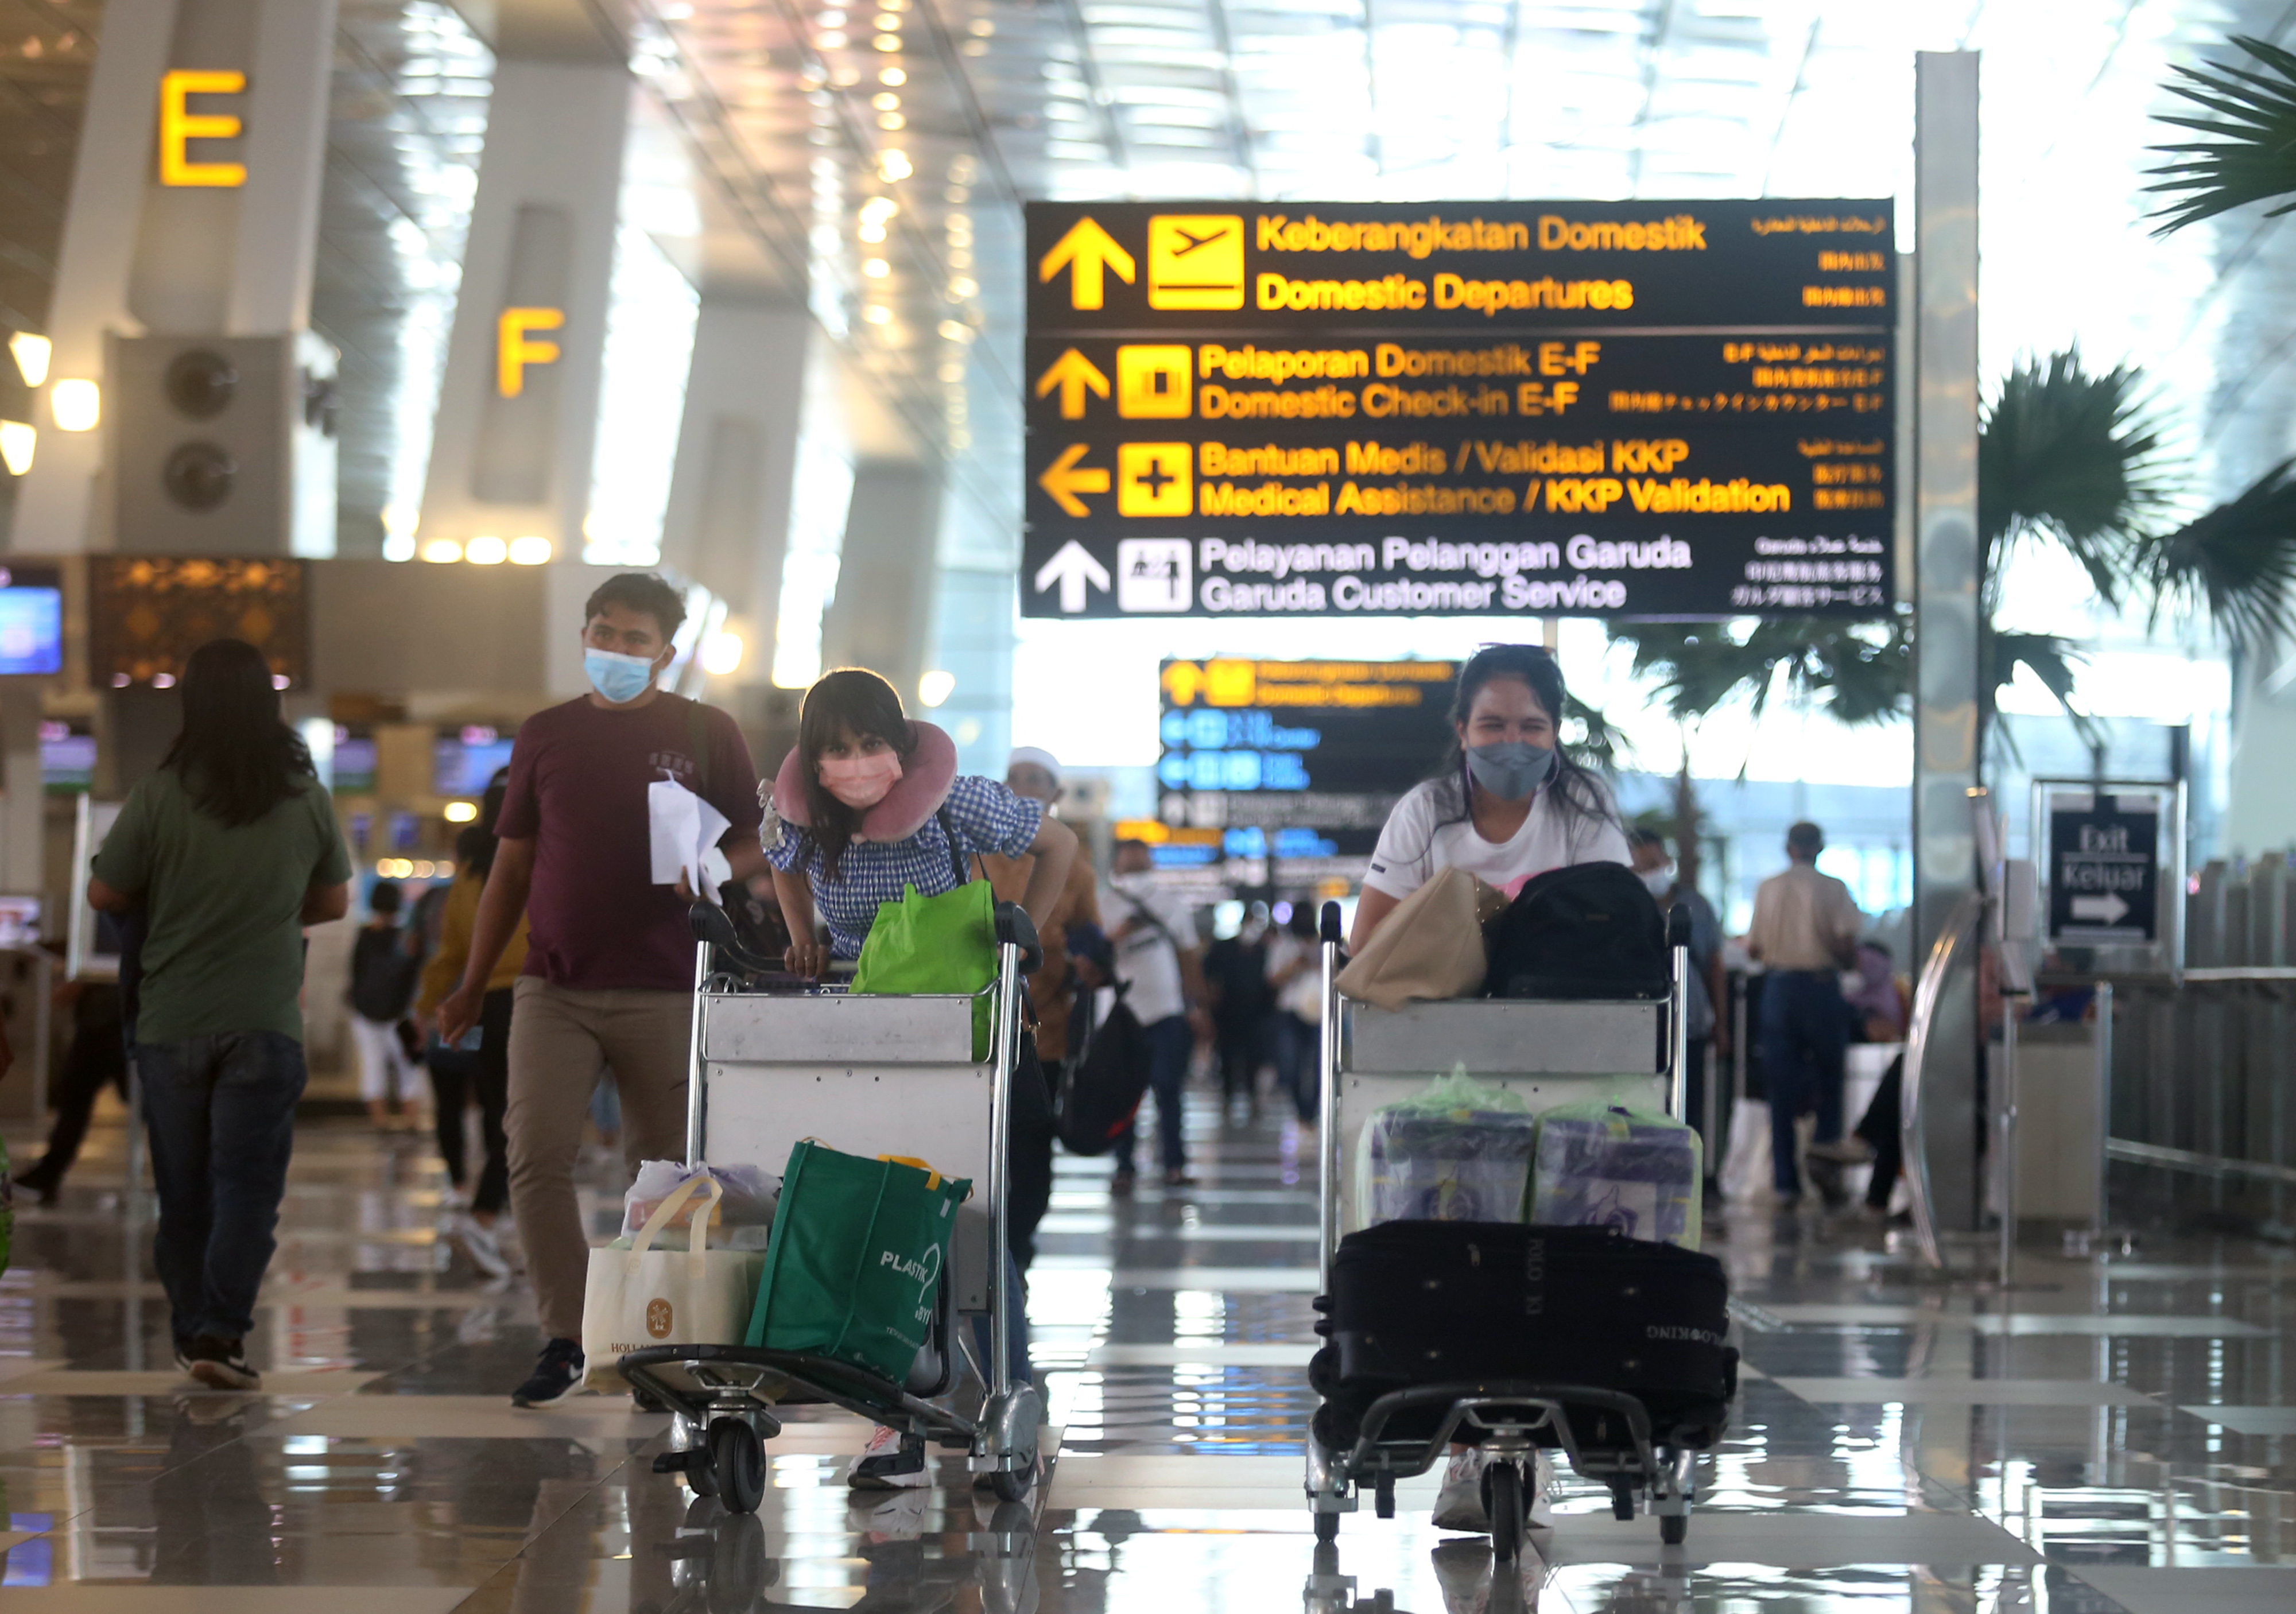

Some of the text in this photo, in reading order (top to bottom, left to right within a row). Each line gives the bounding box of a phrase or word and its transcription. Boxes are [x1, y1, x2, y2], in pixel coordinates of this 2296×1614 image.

[160, 69, 248, 187] E
[1256, 215, 1529, 259] Keberangkatan
[1538, 215, 1707, 251] Domestik
[1256, 273, 1634, 315] Domestic Departures
[498, 306, 565, 399] F
[1199, 341, 1601, 385] Pelaporan Domestik E-F
[1199, 381, 1580, 418] Domestic Check-in E-F
[1199, 439, 1689, 476] Bantuan Medis / Validasi KKP
[1199, 481, 1330, 517] Medical
[1335, 481, 1517, 516] Assistance
[1522, 478, 1541, 513] /
[1546, 478, 1623, 513] KKP
[1626, 478, 1791, 513] Validation
[1199, 534, 1693, 579] Pelayanan Pelanggan Garuda
[1200, 574, 1627, 612] Garuda Customer Service
[2080, 824, 2130, 852] Exit
[2061, 862, 2146, 890] Keluar
